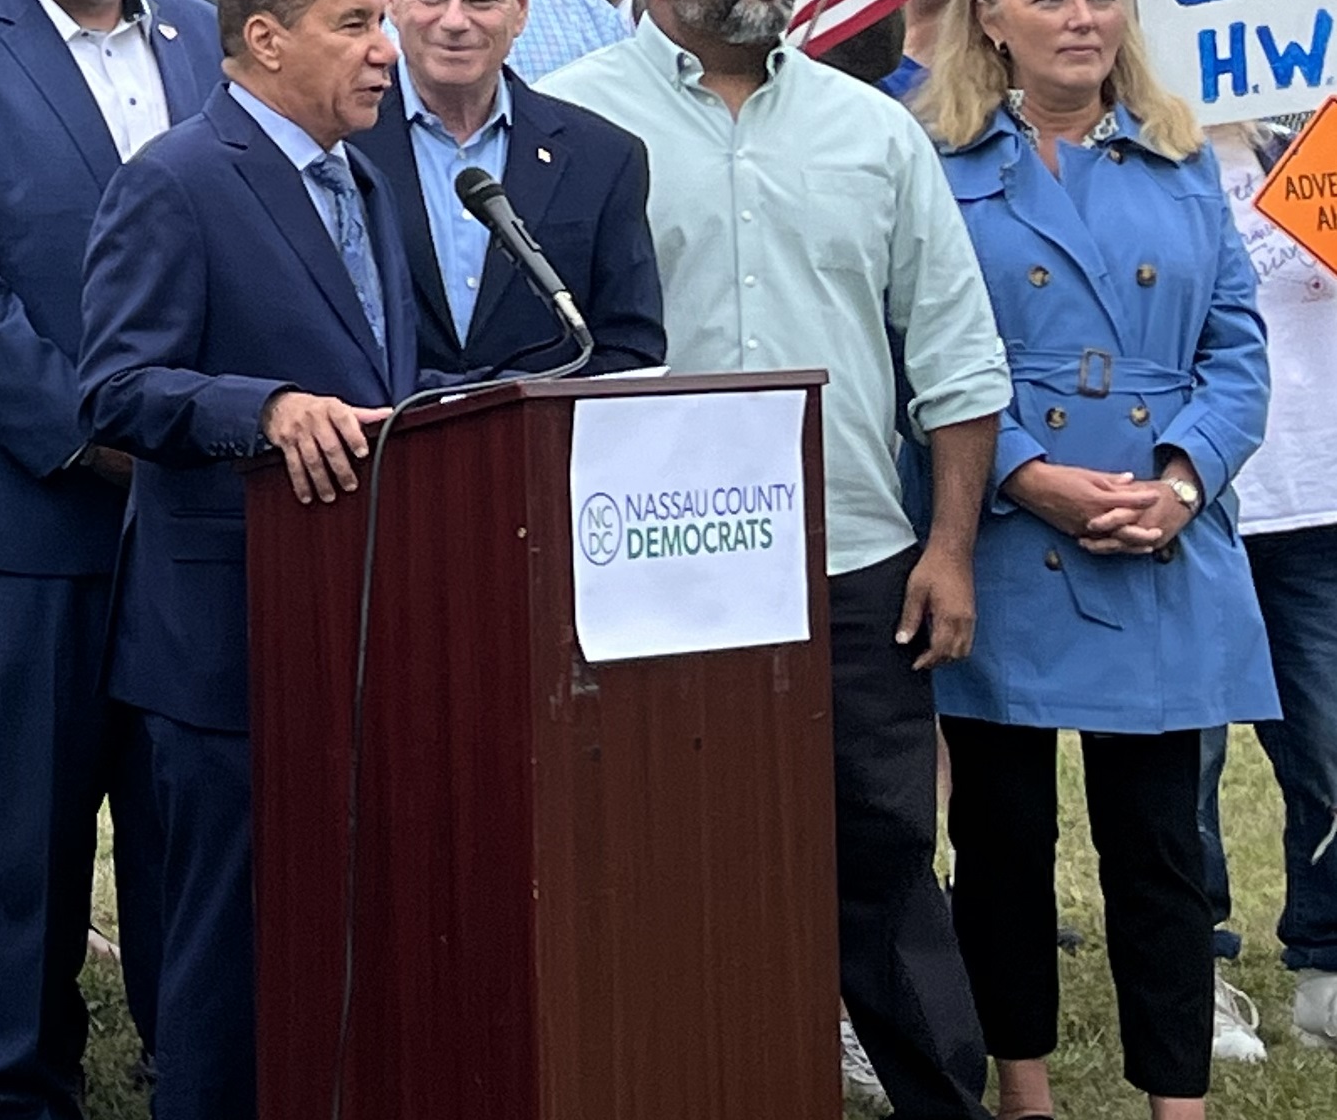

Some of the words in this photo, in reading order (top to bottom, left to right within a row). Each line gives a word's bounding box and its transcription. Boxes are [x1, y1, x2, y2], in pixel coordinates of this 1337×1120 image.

[626, 489, 708, 521] NASSAU
[712, 482, 796, 516] COUNTY
[587, 506, 613, 529] NC
[588, 531, 613, 555] DC
[627, 518, 773, 560] DEMOCRATS
